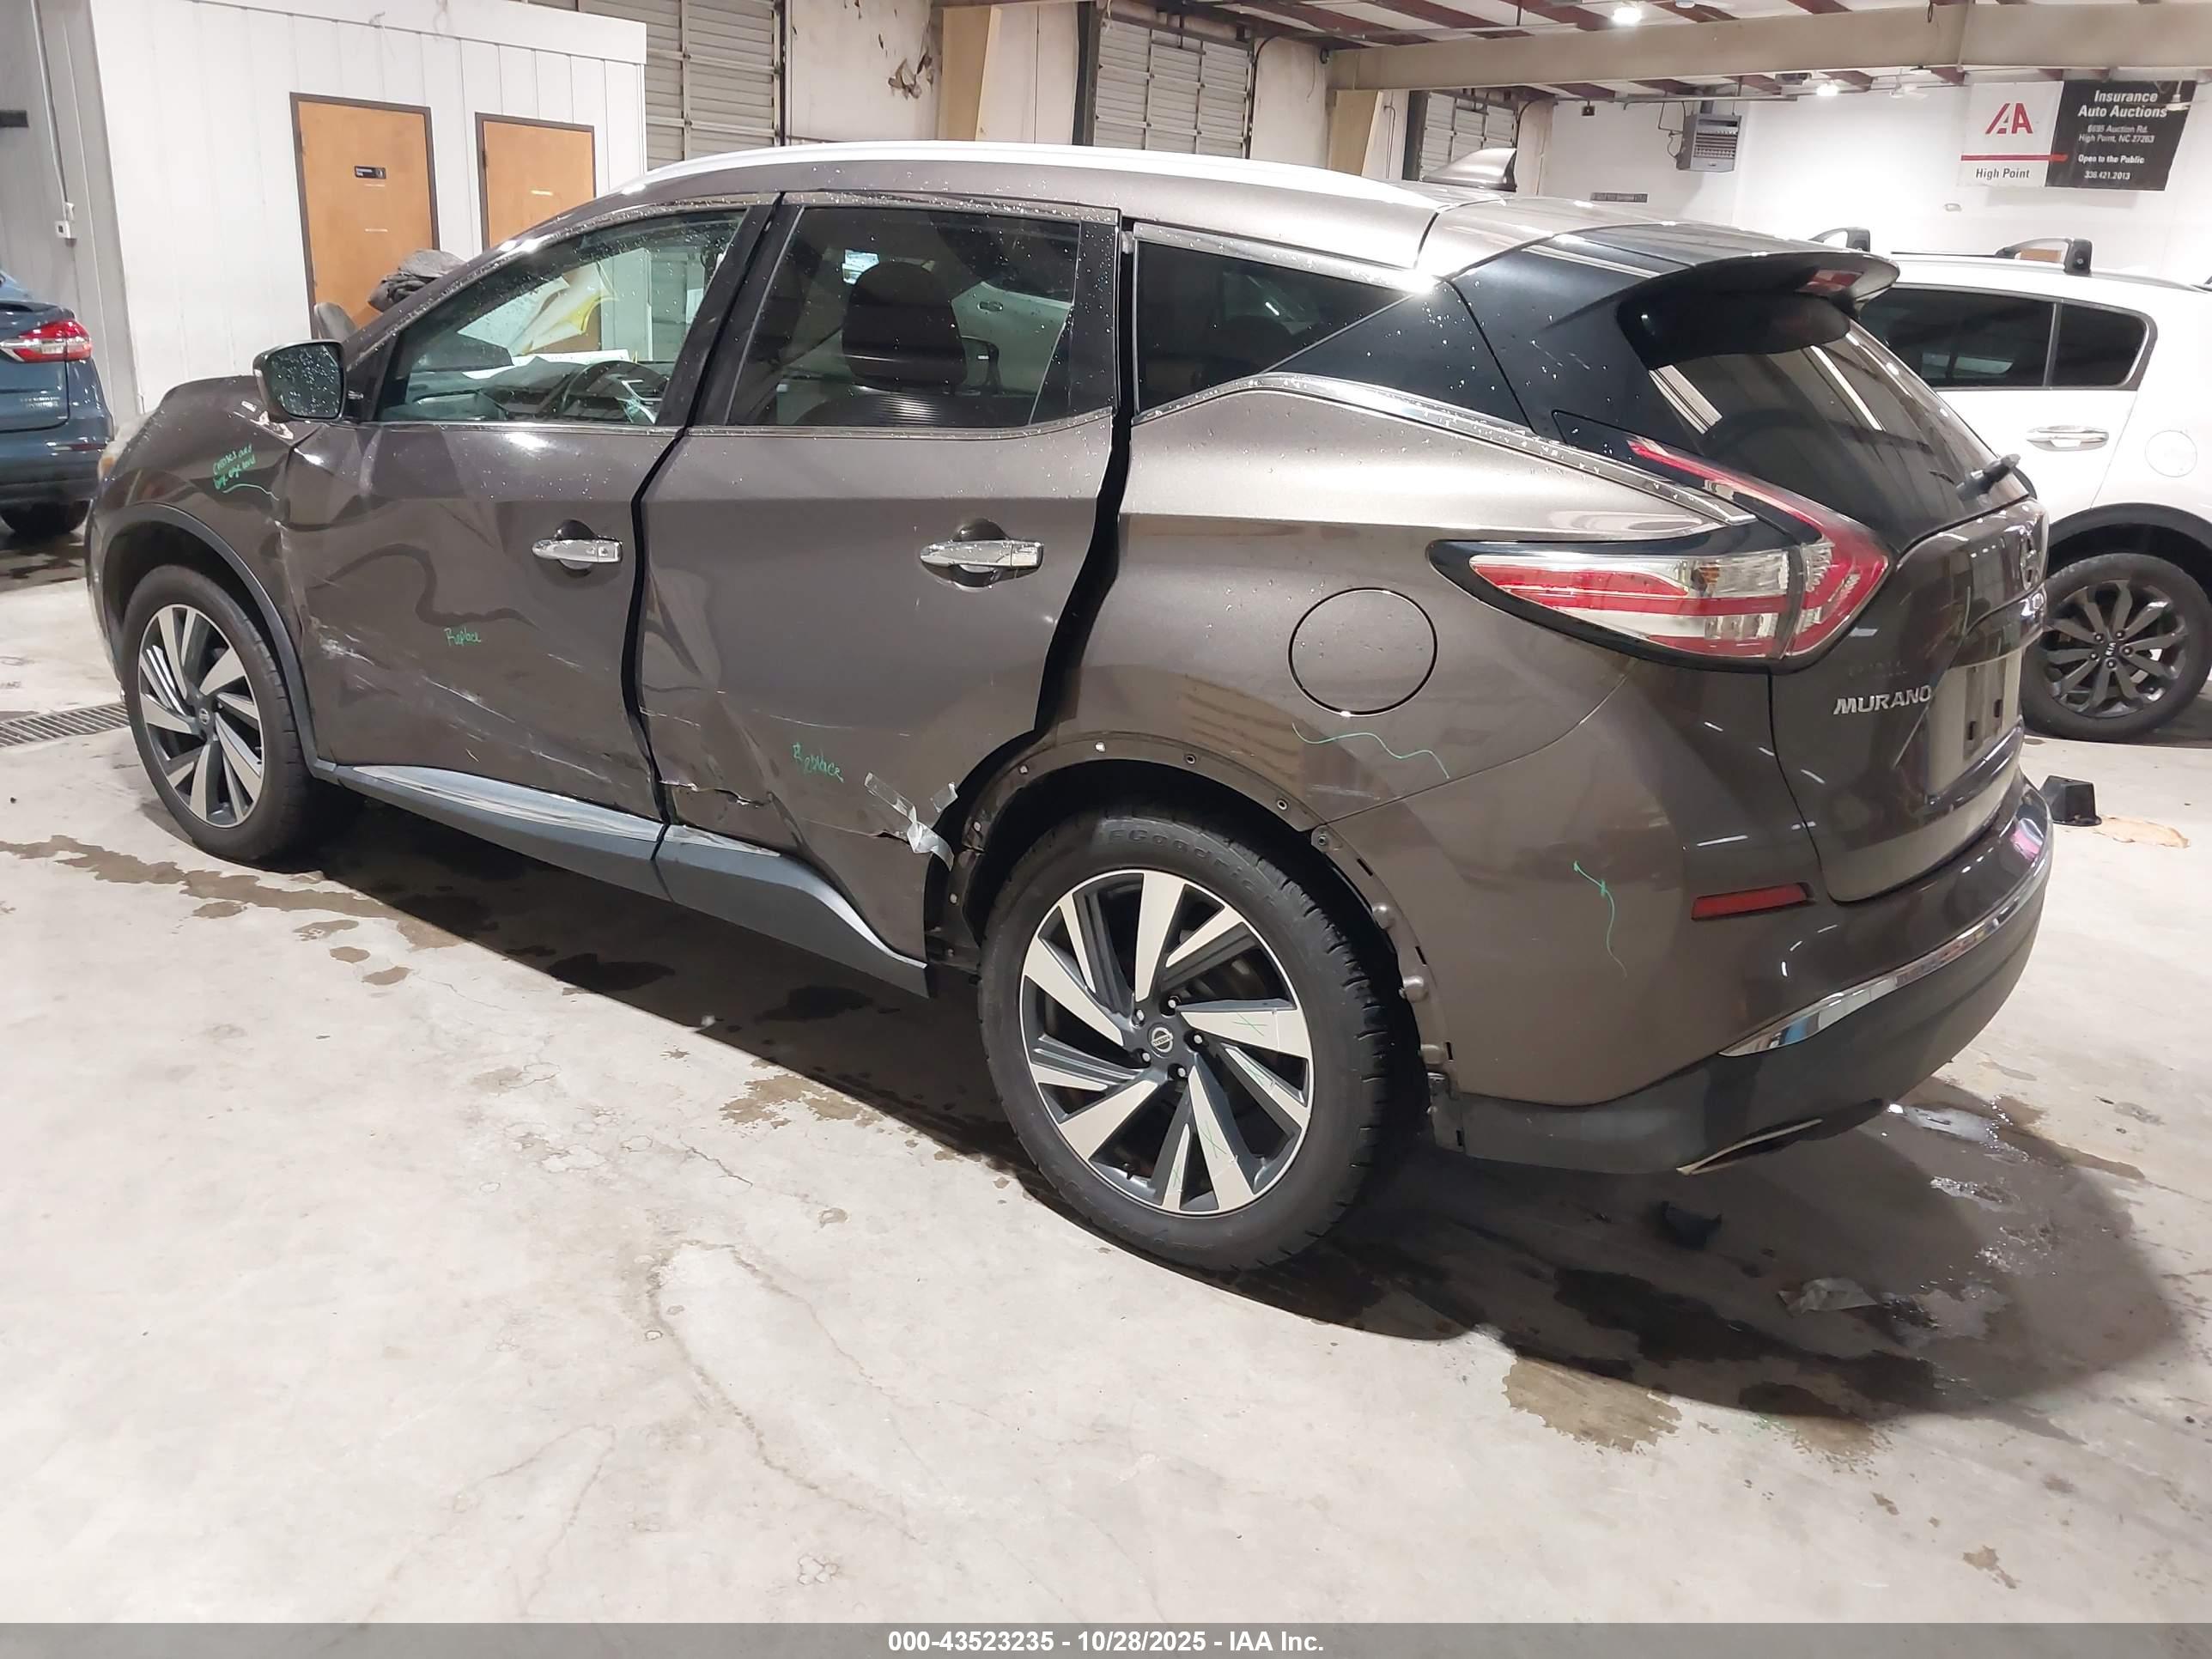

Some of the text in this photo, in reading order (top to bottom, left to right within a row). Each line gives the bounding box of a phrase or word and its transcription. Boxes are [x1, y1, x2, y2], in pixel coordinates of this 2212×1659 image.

[2094, 89, 2158, 103] Insurance
[2077, 104, 2167, 118] Auto Auctions
[2106, 125, 2135, 133] Auction
[2079, 133, 2095, 143] High
[2118, 134, 2130, 143] NC
[2078, 154, 2097, 165] Open
[2106, 155, 2118, 163] the
[2120, 155, 2145, 164] Public
[1976, 167, 2030, 180] High Point
[2084, 170, 2131, 180] 336.421.2013
[2105, 641, 2117, 656] KIA
[1832, 684, 1932, 715] MURANO
